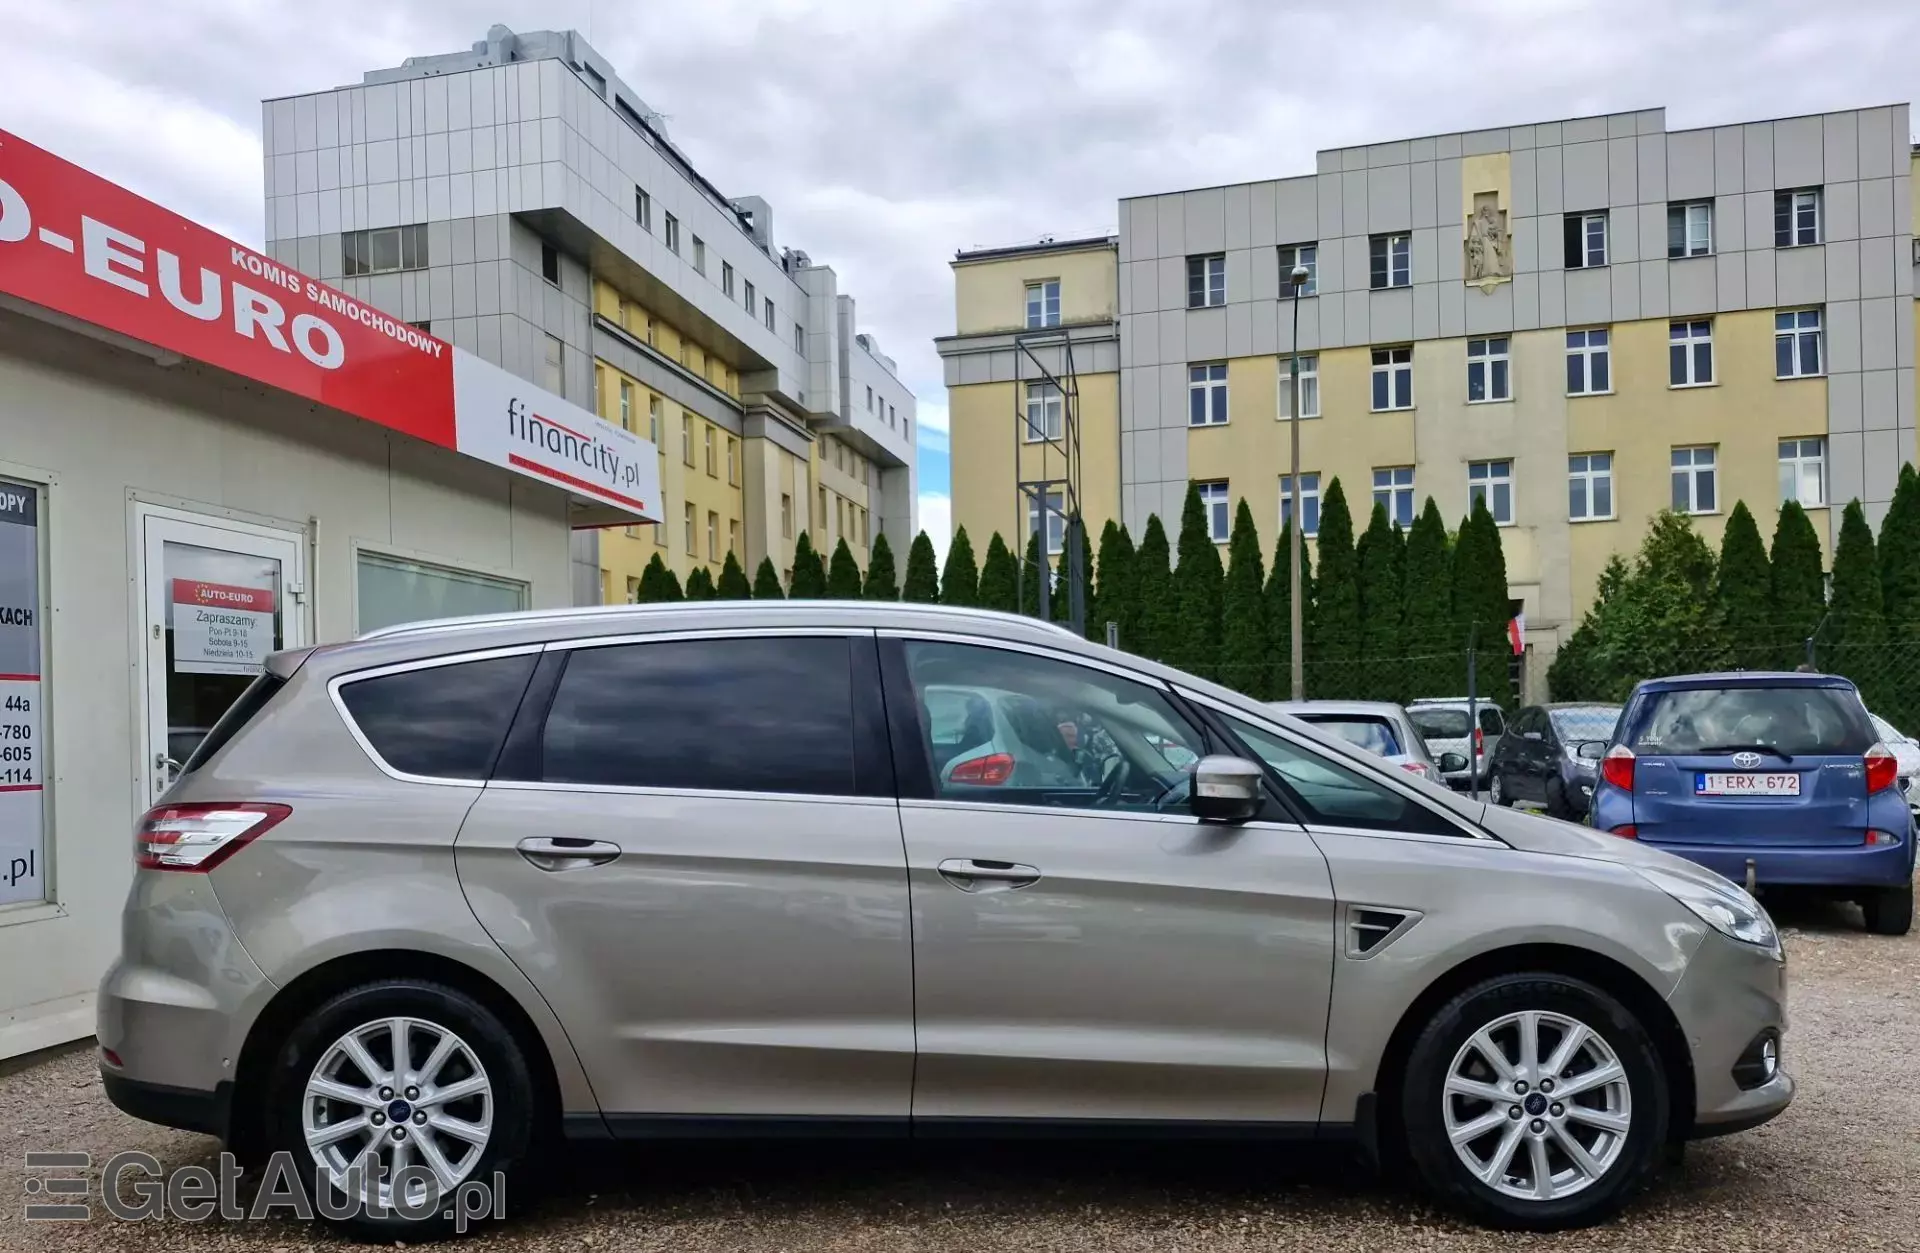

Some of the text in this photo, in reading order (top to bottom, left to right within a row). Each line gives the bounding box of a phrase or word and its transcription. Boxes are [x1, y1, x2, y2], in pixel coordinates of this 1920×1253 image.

[231, 247, 443, 358] KOMIS SAMOCHODOWY
[507, 397, 640, 488] financity.pl
[201, 589, 253, 603] AUTO-EURO
[5, 695, 31, 712] 44a
